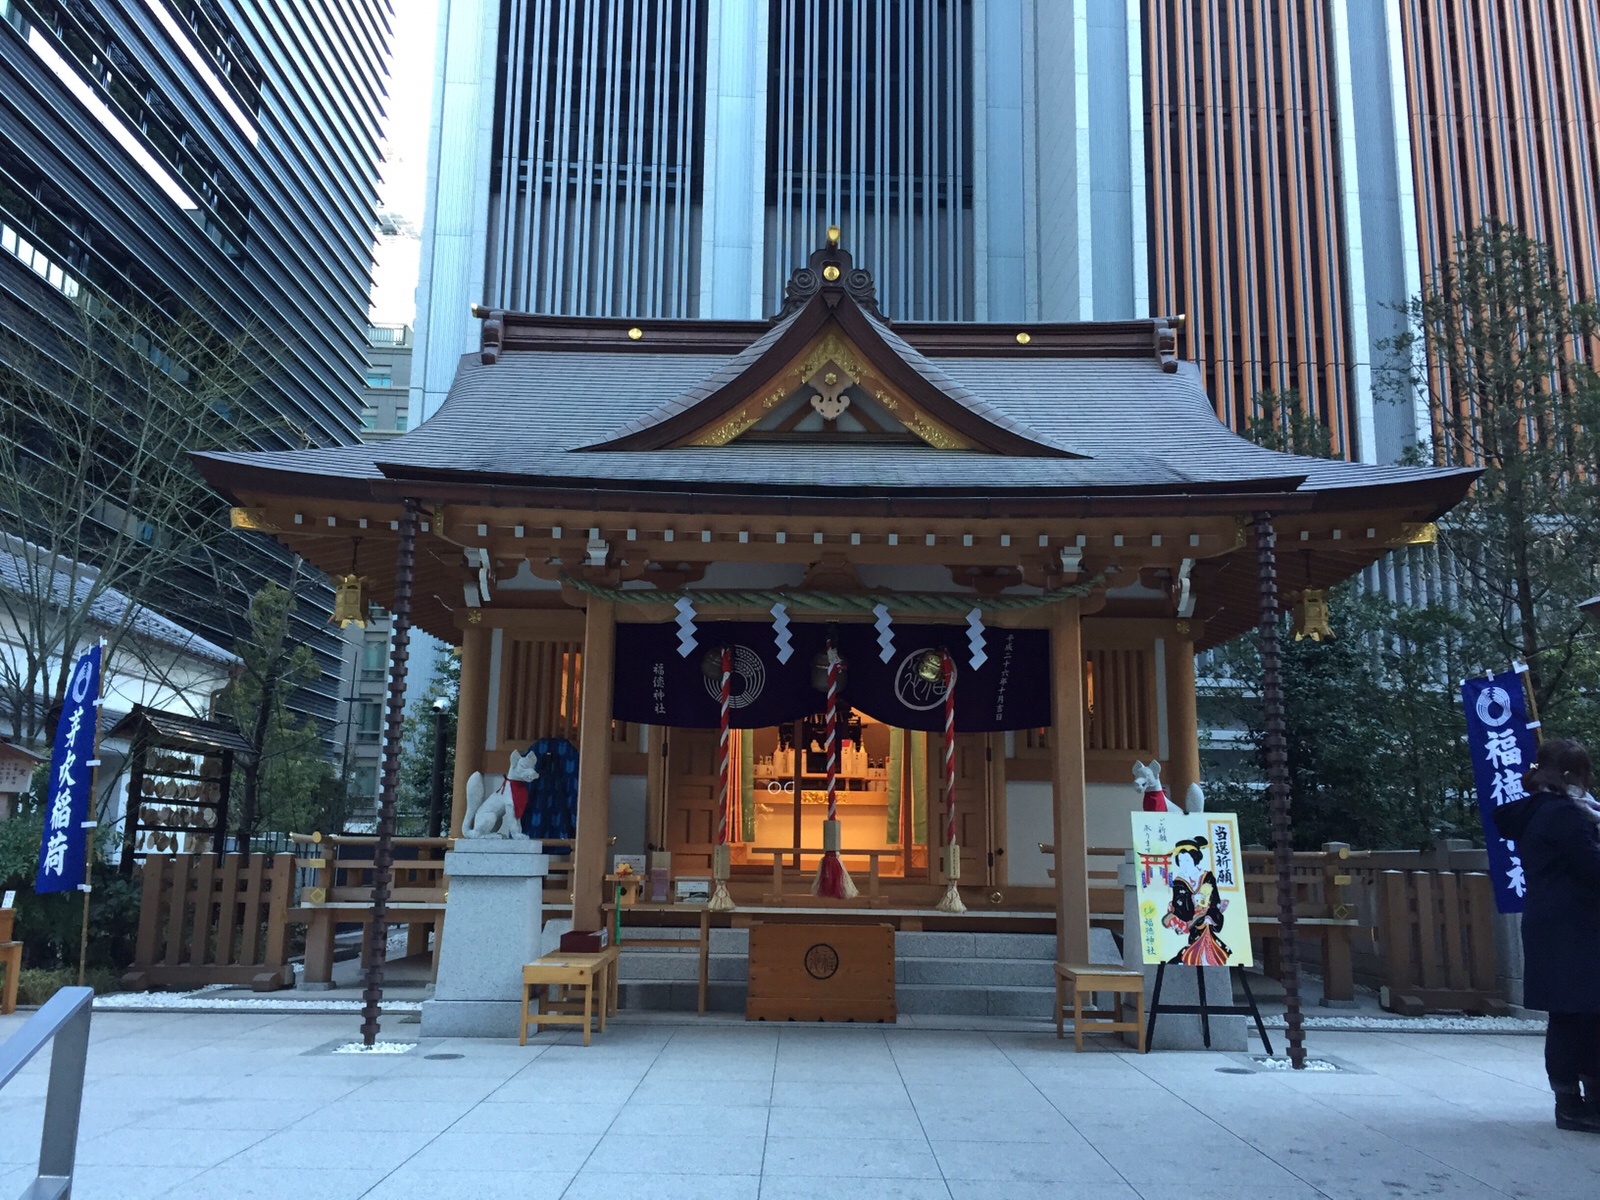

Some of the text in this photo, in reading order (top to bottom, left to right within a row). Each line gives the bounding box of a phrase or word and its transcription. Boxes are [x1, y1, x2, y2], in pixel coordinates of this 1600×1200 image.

[995, 633, 1015, 721] 平成二十六年十月吉日
[43, 705, 85, 877] 芽吹稲荷
[1214, 825, 1234, 886] 当選祈願
[1484, 728, 1531, 898] 福徳社
